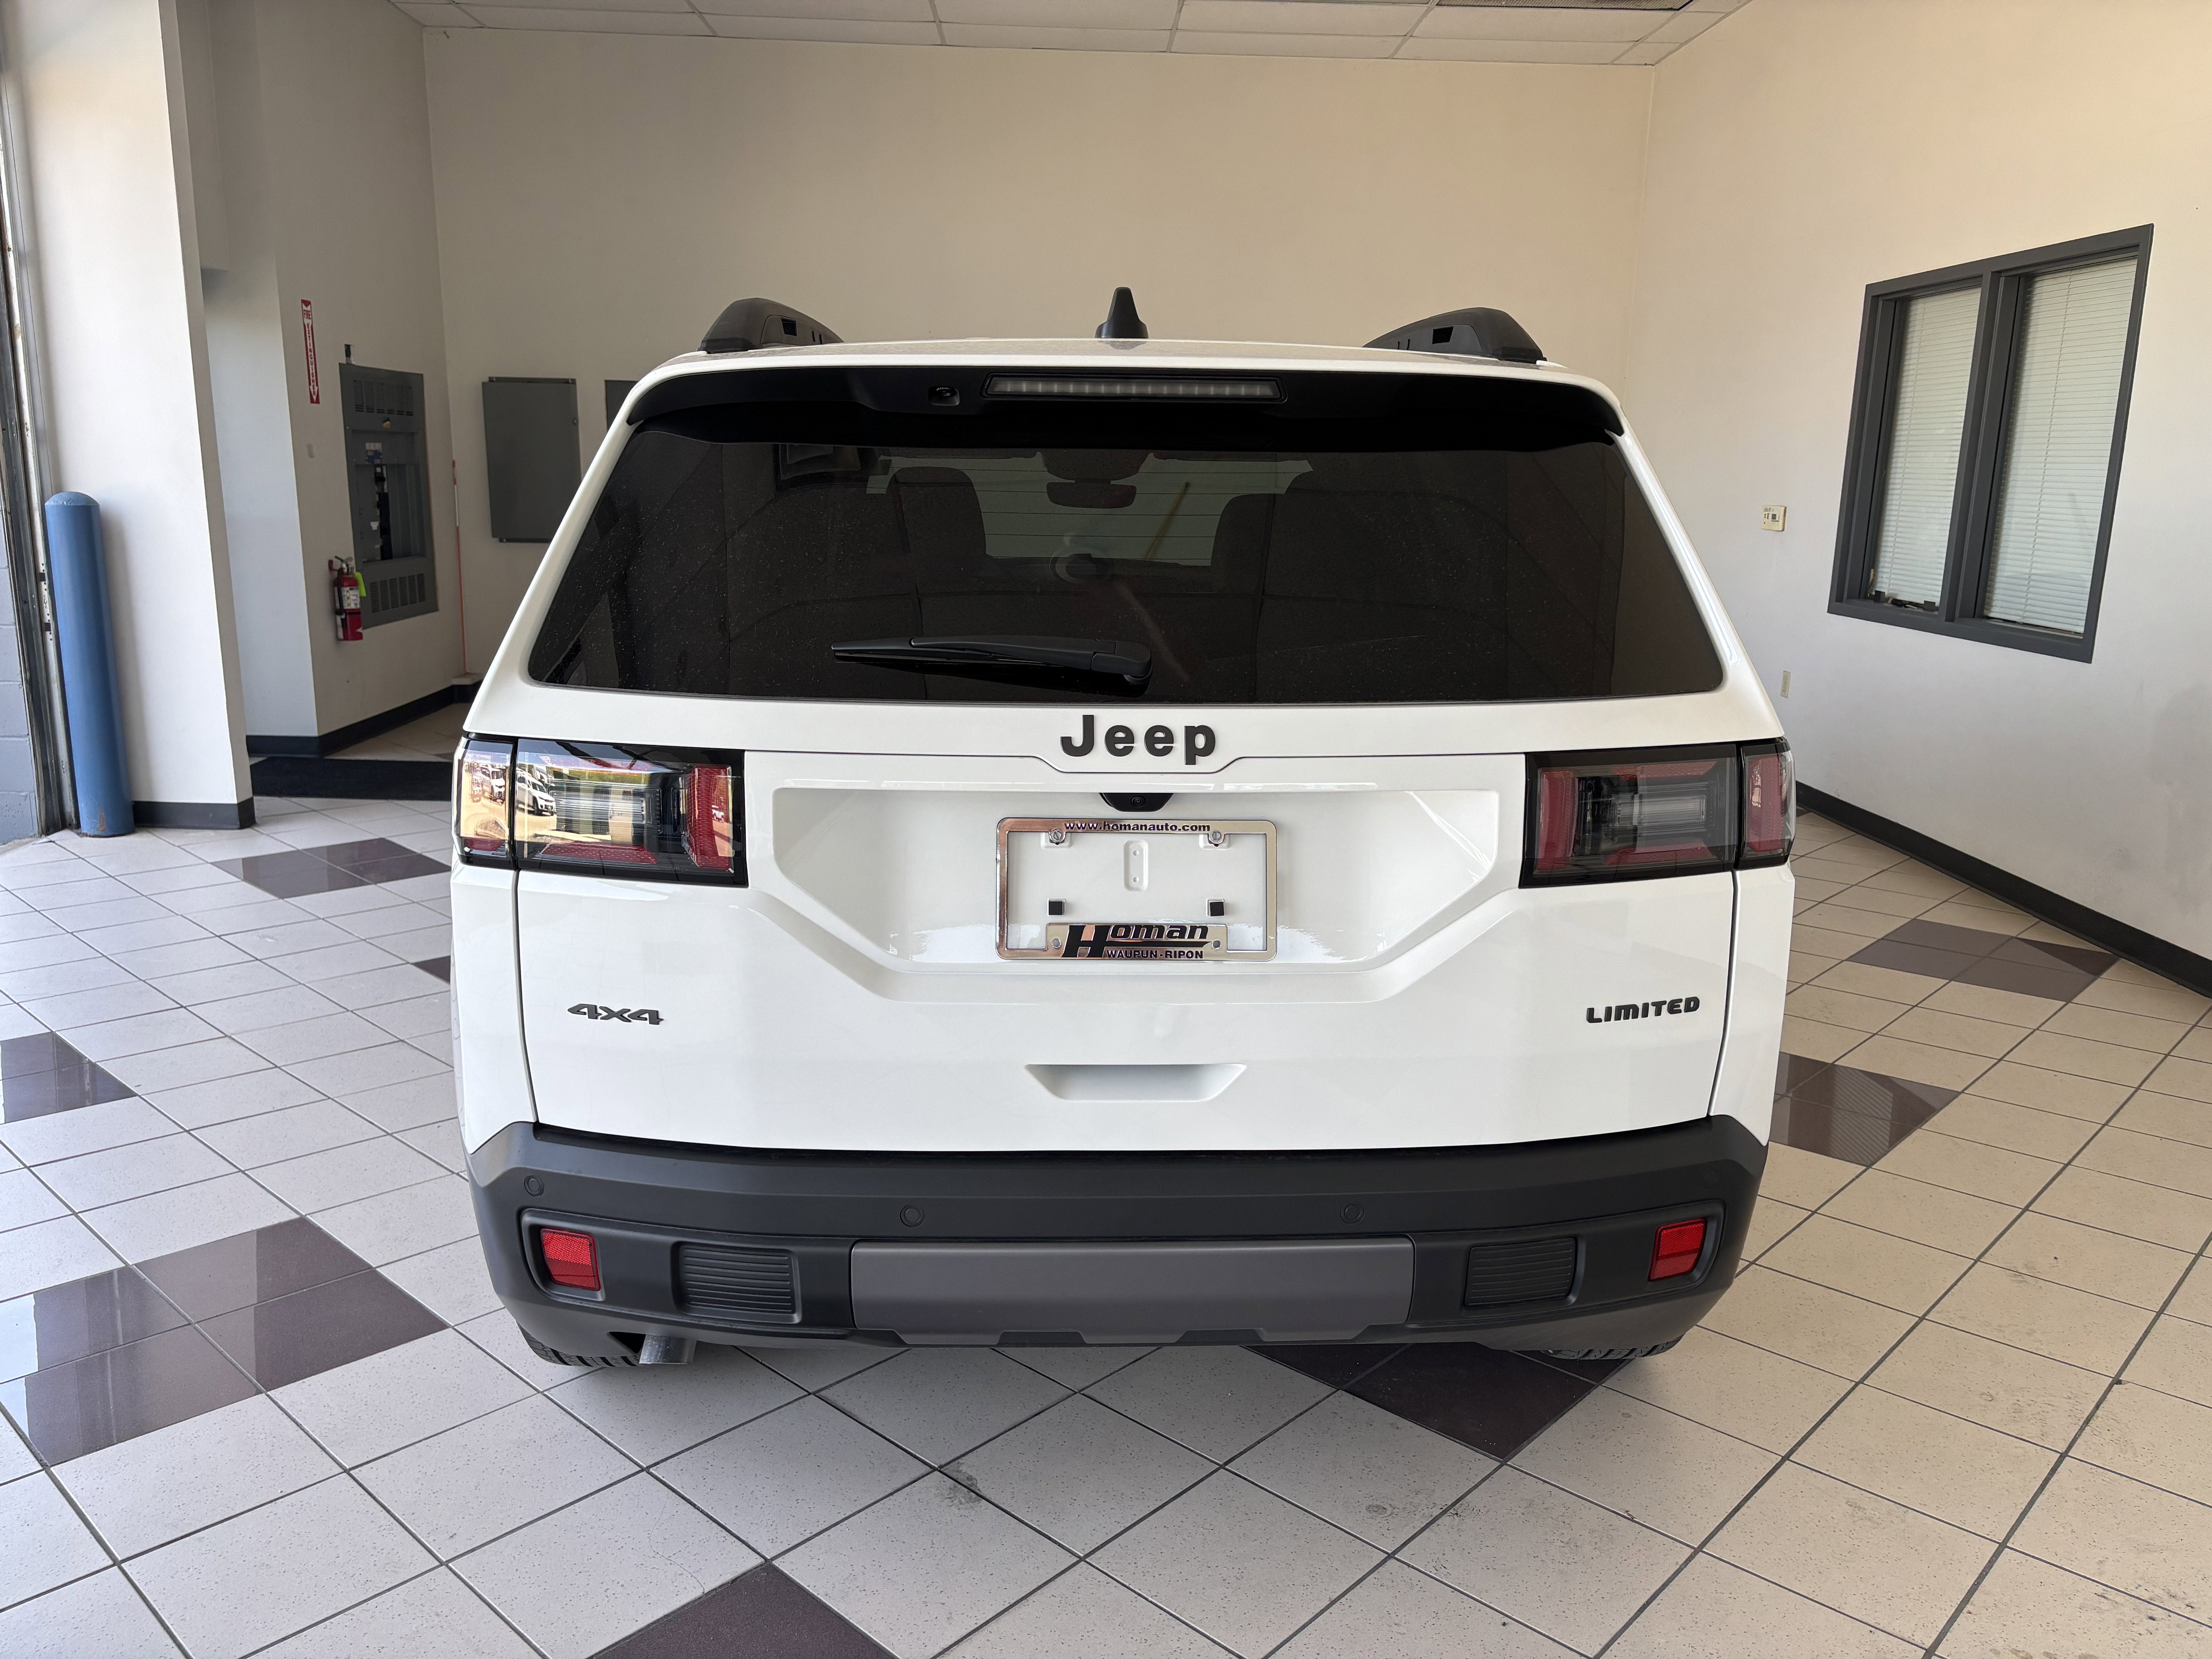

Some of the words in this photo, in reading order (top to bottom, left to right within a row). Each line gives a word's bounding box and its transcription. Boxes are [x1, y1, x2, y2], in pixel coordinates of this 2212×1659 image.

[303, 309, 311, 319] FIRE
[1060, 714, 1216, 765] Jeep
[1065, 821, 1211, 831] www.homanauto.com
[1061, 924, 1209, 958] Homan
[1586, 996, 1700, 1024] LIMITED
